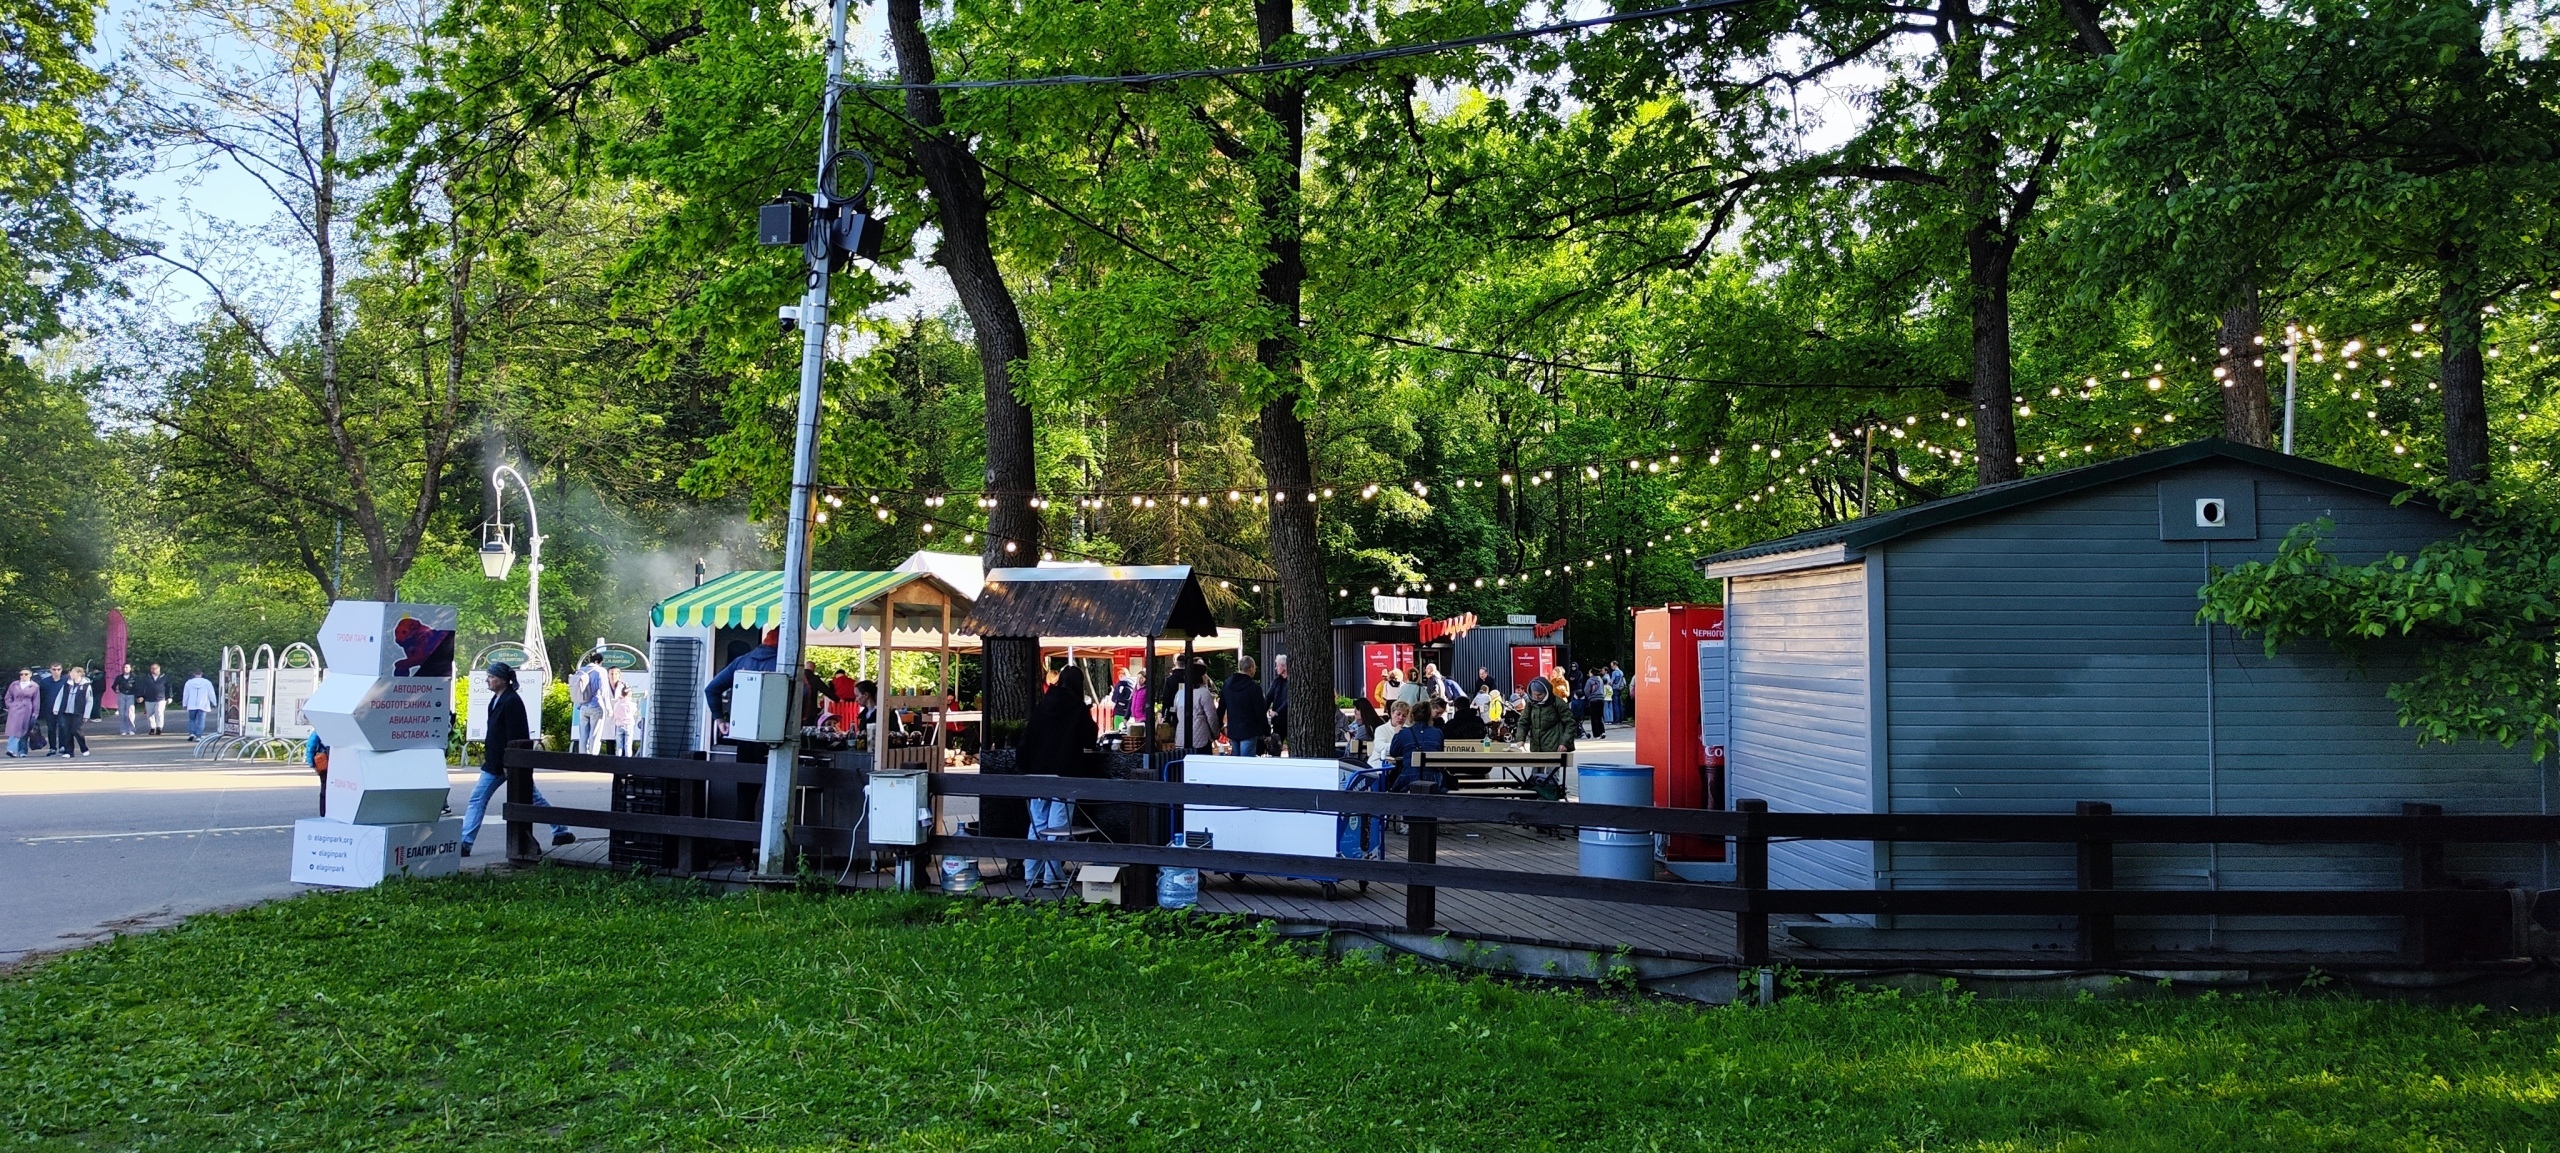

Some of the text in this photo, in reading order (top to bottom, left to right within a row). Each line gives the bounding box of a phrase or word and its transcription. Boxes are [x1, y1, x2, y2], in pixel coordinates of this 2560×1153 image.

[1374, 595, 1428, 615] CENTRAL PARK
[1418, 611, 1477, 643] Пицца
[393, 685, 433, 694] АВТОДРОМ
[371, 701, 431, 709] РОБОТОТЕХНИКА
[389, 716, 431, 724] АВИААНГАР
[391, 730, 429, 739] ВЫСТАВКА
[314, 834, 353, 845] elaginpark.org
[406, 840, 458, 858] ЕЛАГИН СЛЁТ
[319, 850, 347, 859] elaginpark
[316, 864, 345, 873] elaginpark
